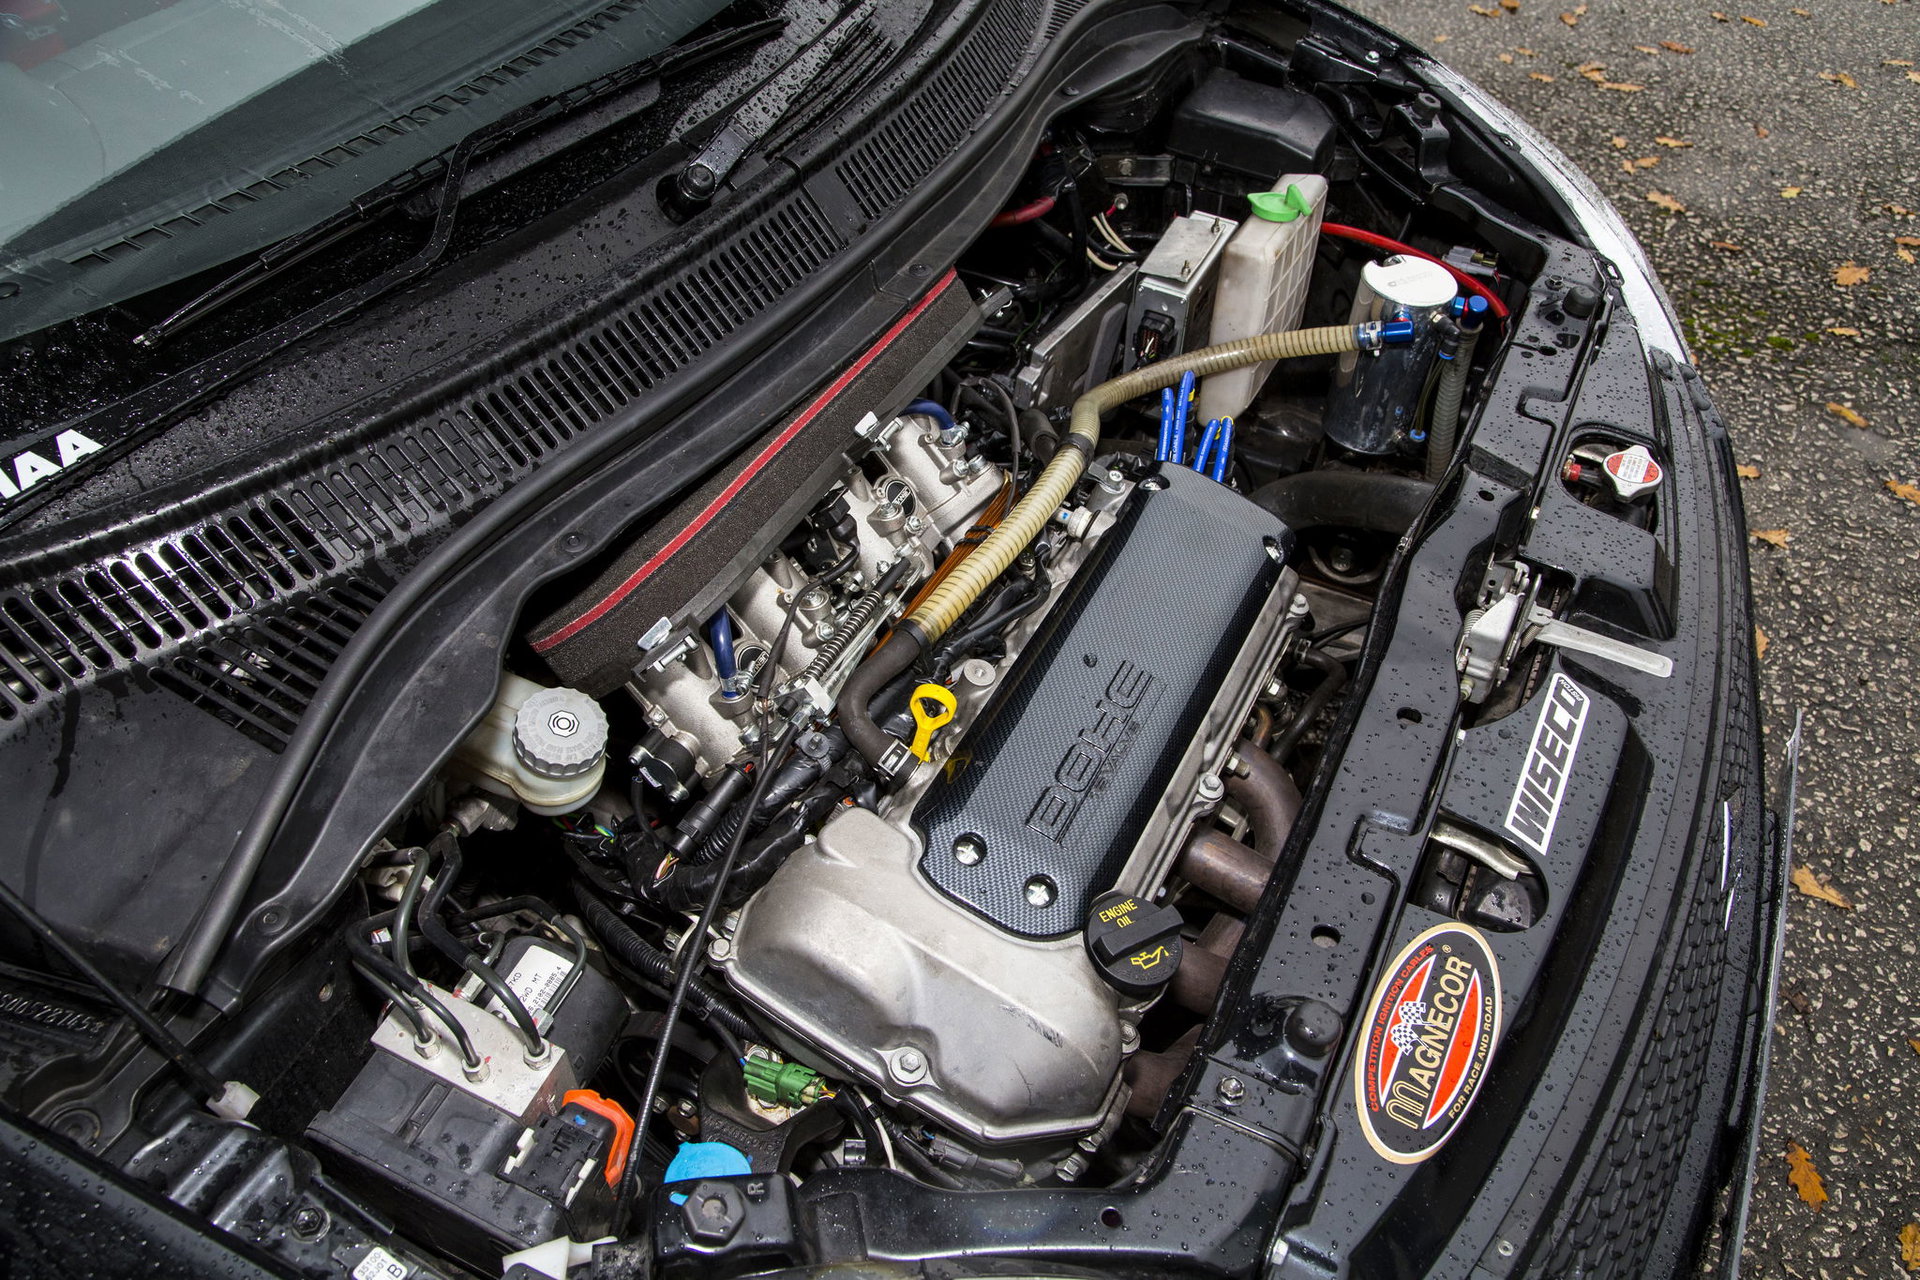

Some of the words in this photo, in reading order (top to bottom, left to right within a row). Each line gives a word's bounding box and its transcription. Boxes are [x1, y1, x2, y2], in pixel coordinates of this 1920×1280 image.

[0, 428, 104, 499] AA
[1558, 678, 1584, 702] PISTON
[1511, 676, 1585, 847] WISECO
[1098, 898, 1138, 923] ENGINE
[1116, 915, 1133, 928] OIL
[532, 972, 542, 985] MT
[1484, 995, 1493, 1031] ROAD
[1367, 1027, 1382, 1113] COMPETITION
[1379, 982, 1402, 1026] IGNITION
[1401, 944, 1435, 979] CABLES
[1478, 1032, 1491, 1061] AND
[1462, 1062, 1482, 1096] RACE
[1448, 1096, 1467, 1120] FOR
[387, 1263, 403, 1278] B
